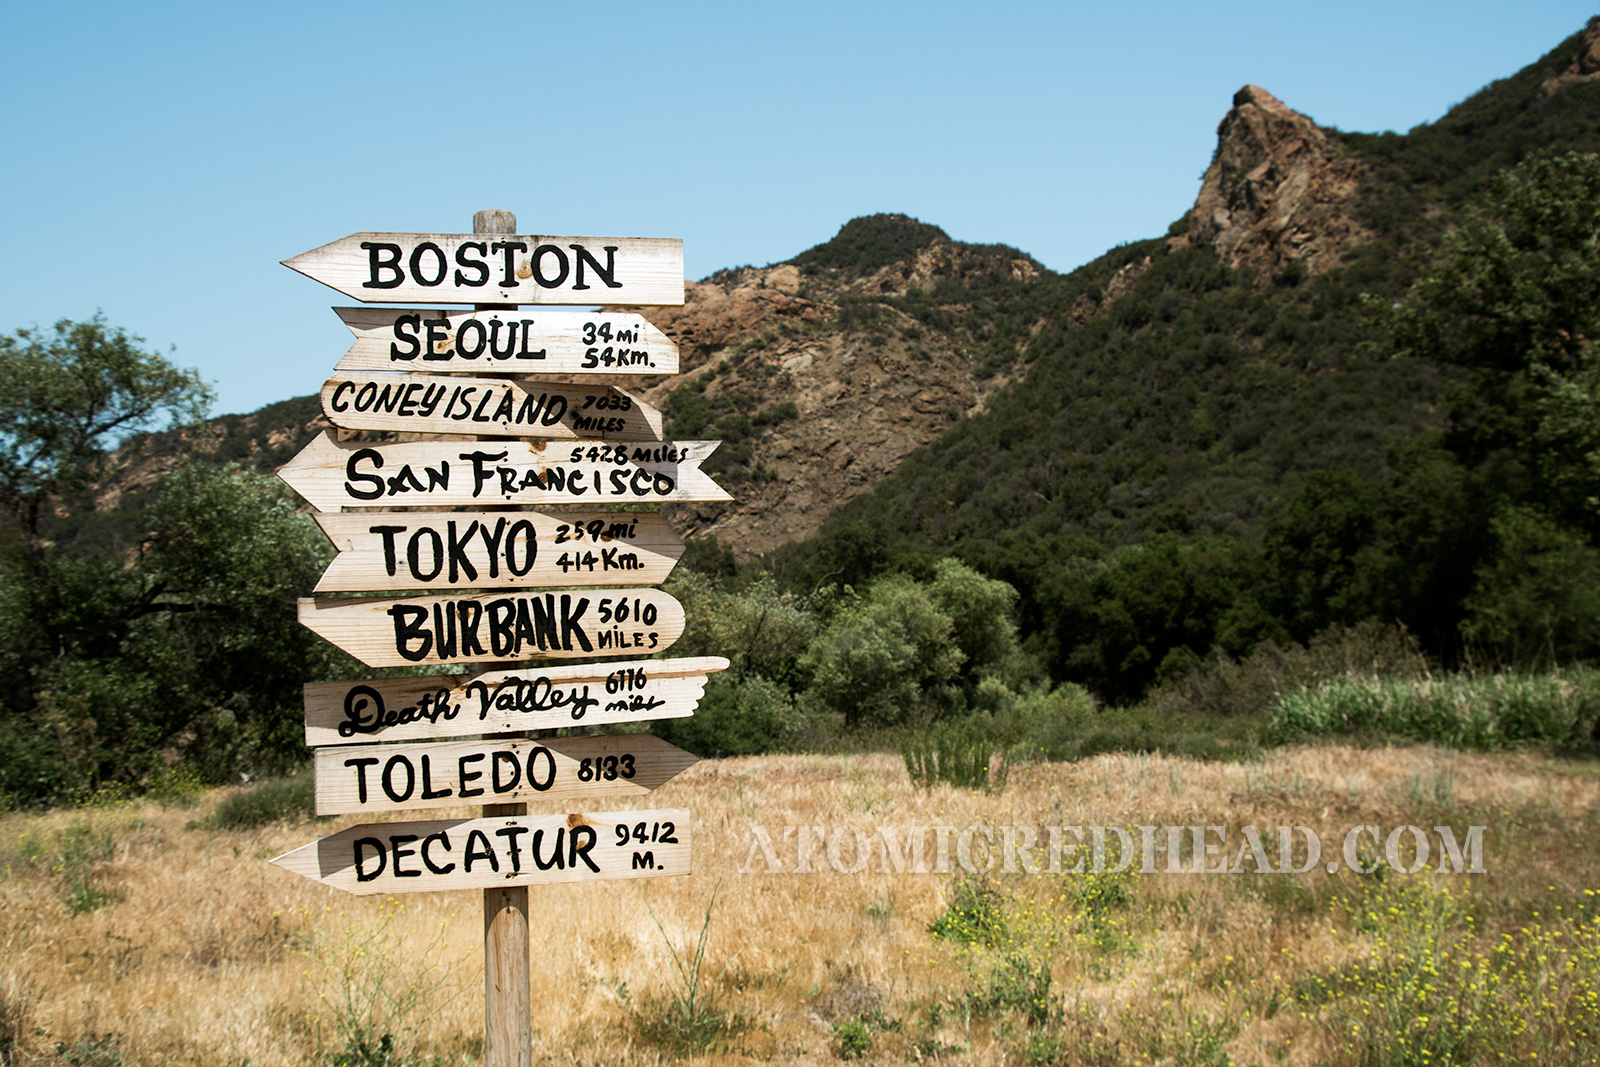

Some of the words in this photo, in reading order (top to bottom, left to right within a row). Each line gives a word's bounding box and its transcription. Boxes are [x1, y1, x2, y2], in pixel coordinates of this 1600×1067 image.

[360, 242, 623, 289] BOSTON
[391, 314, 546, 361] SEOUL
[582, 322, 613, 345] 34
[331, 381, 446, 417] CONEY
[444, 385, 568, 426] ISLAND
[581, 395, 632, 411] 7033
[573, 416, 627, 433] MILES
[570, 446, 628, 464] 5428
[344, 448, 450, 500] SAN
[459, 451, 675, 498] FRANCISCO
[555, 522, 600, 544] 259
[369, 517, 537, 584] TOKYO
[555, 551, 599, 573] 414
[597, 598, 658, 626] 5610
[387, 594, 595, 662] BURBANK
[338, 685, 460, 737] Death
[465, 676, 599, 720] Valley
[344, 746, 557, 804] TOLEDO
[577, 754, 637, 782] 8133
[615, 822, 679, 847] 9412
[353, 825, 601, 882] DECATUR
[632, 851, 665, 870] M.
